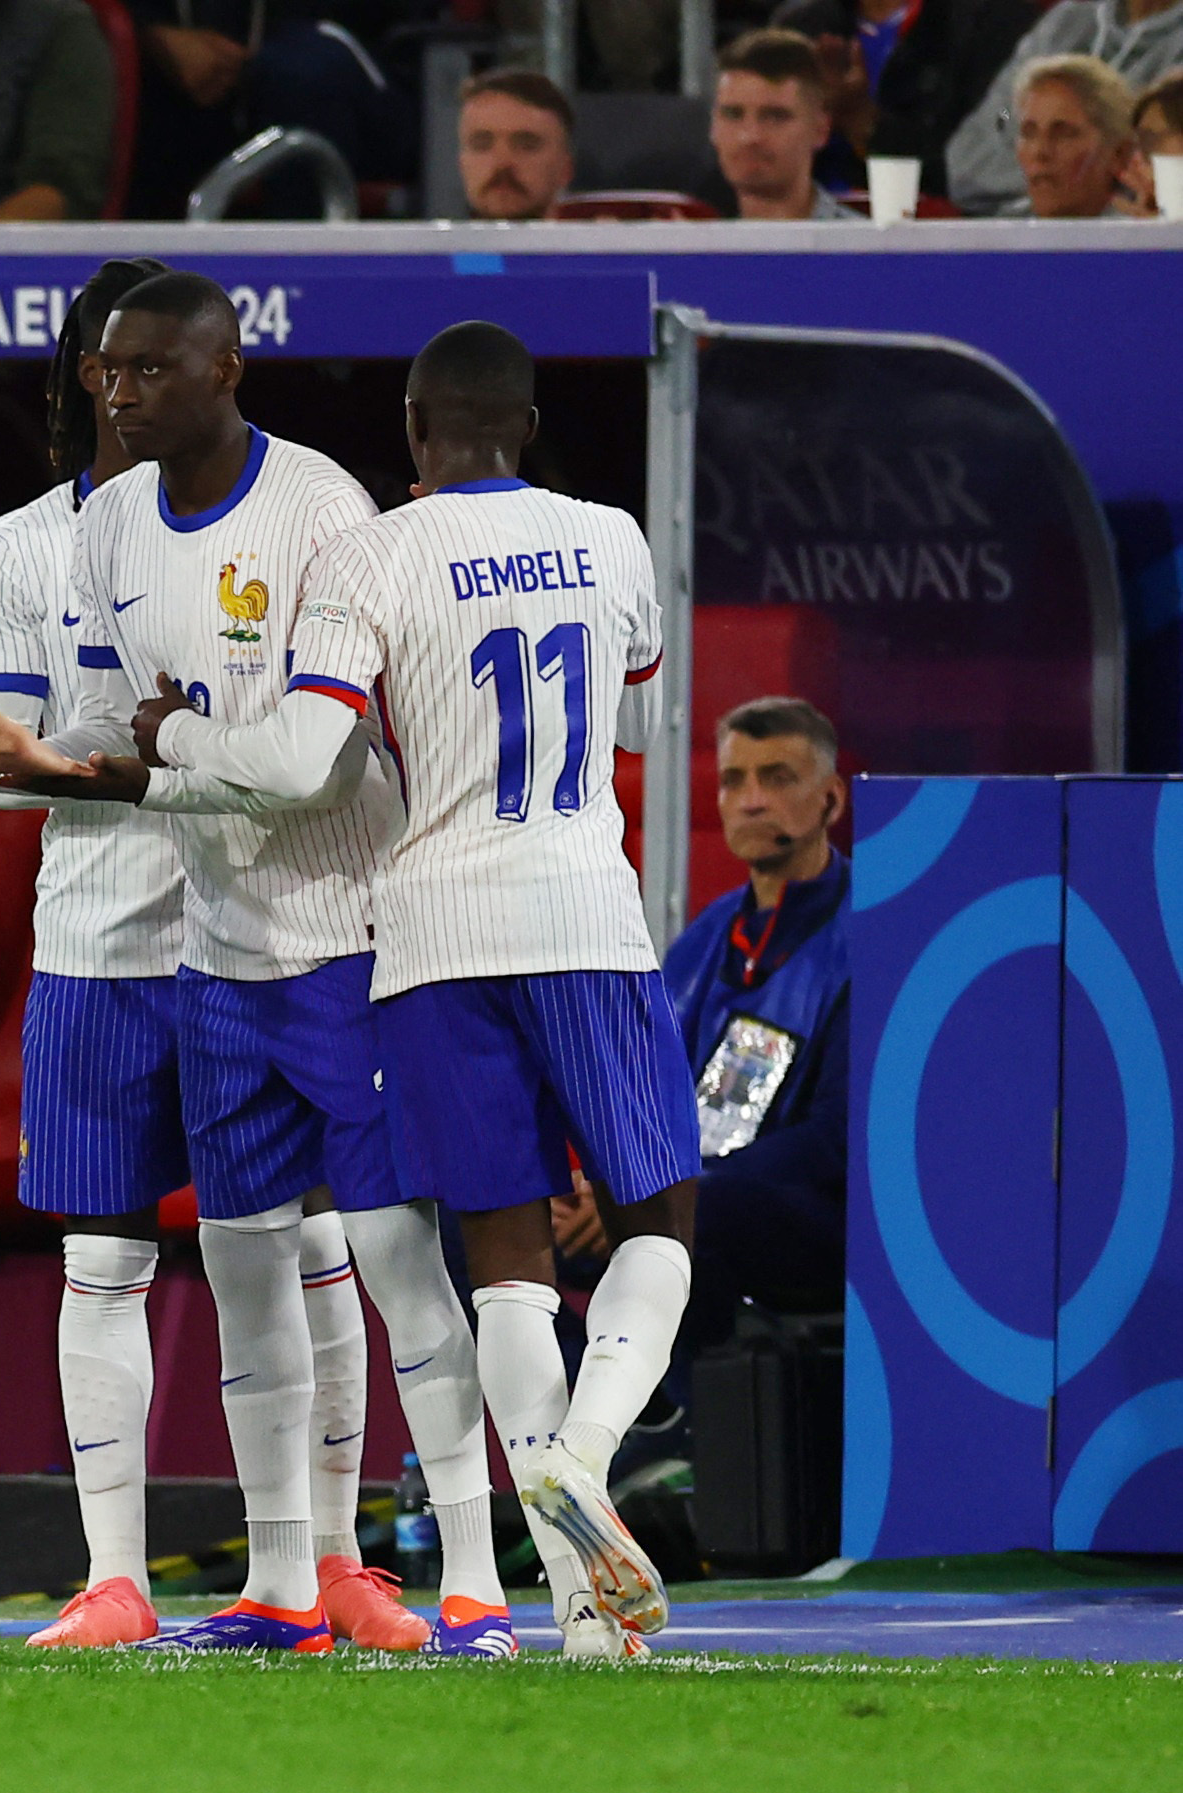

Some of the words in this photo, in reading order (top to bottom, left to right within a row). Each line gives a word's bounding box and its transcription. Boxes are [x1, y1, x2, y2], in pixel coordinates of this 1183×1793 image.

[449, 549, 596, 601] DEMBELE
[762, 541, 1013, 602] AIRWAYS
[471, 622, 591, 823] 11
